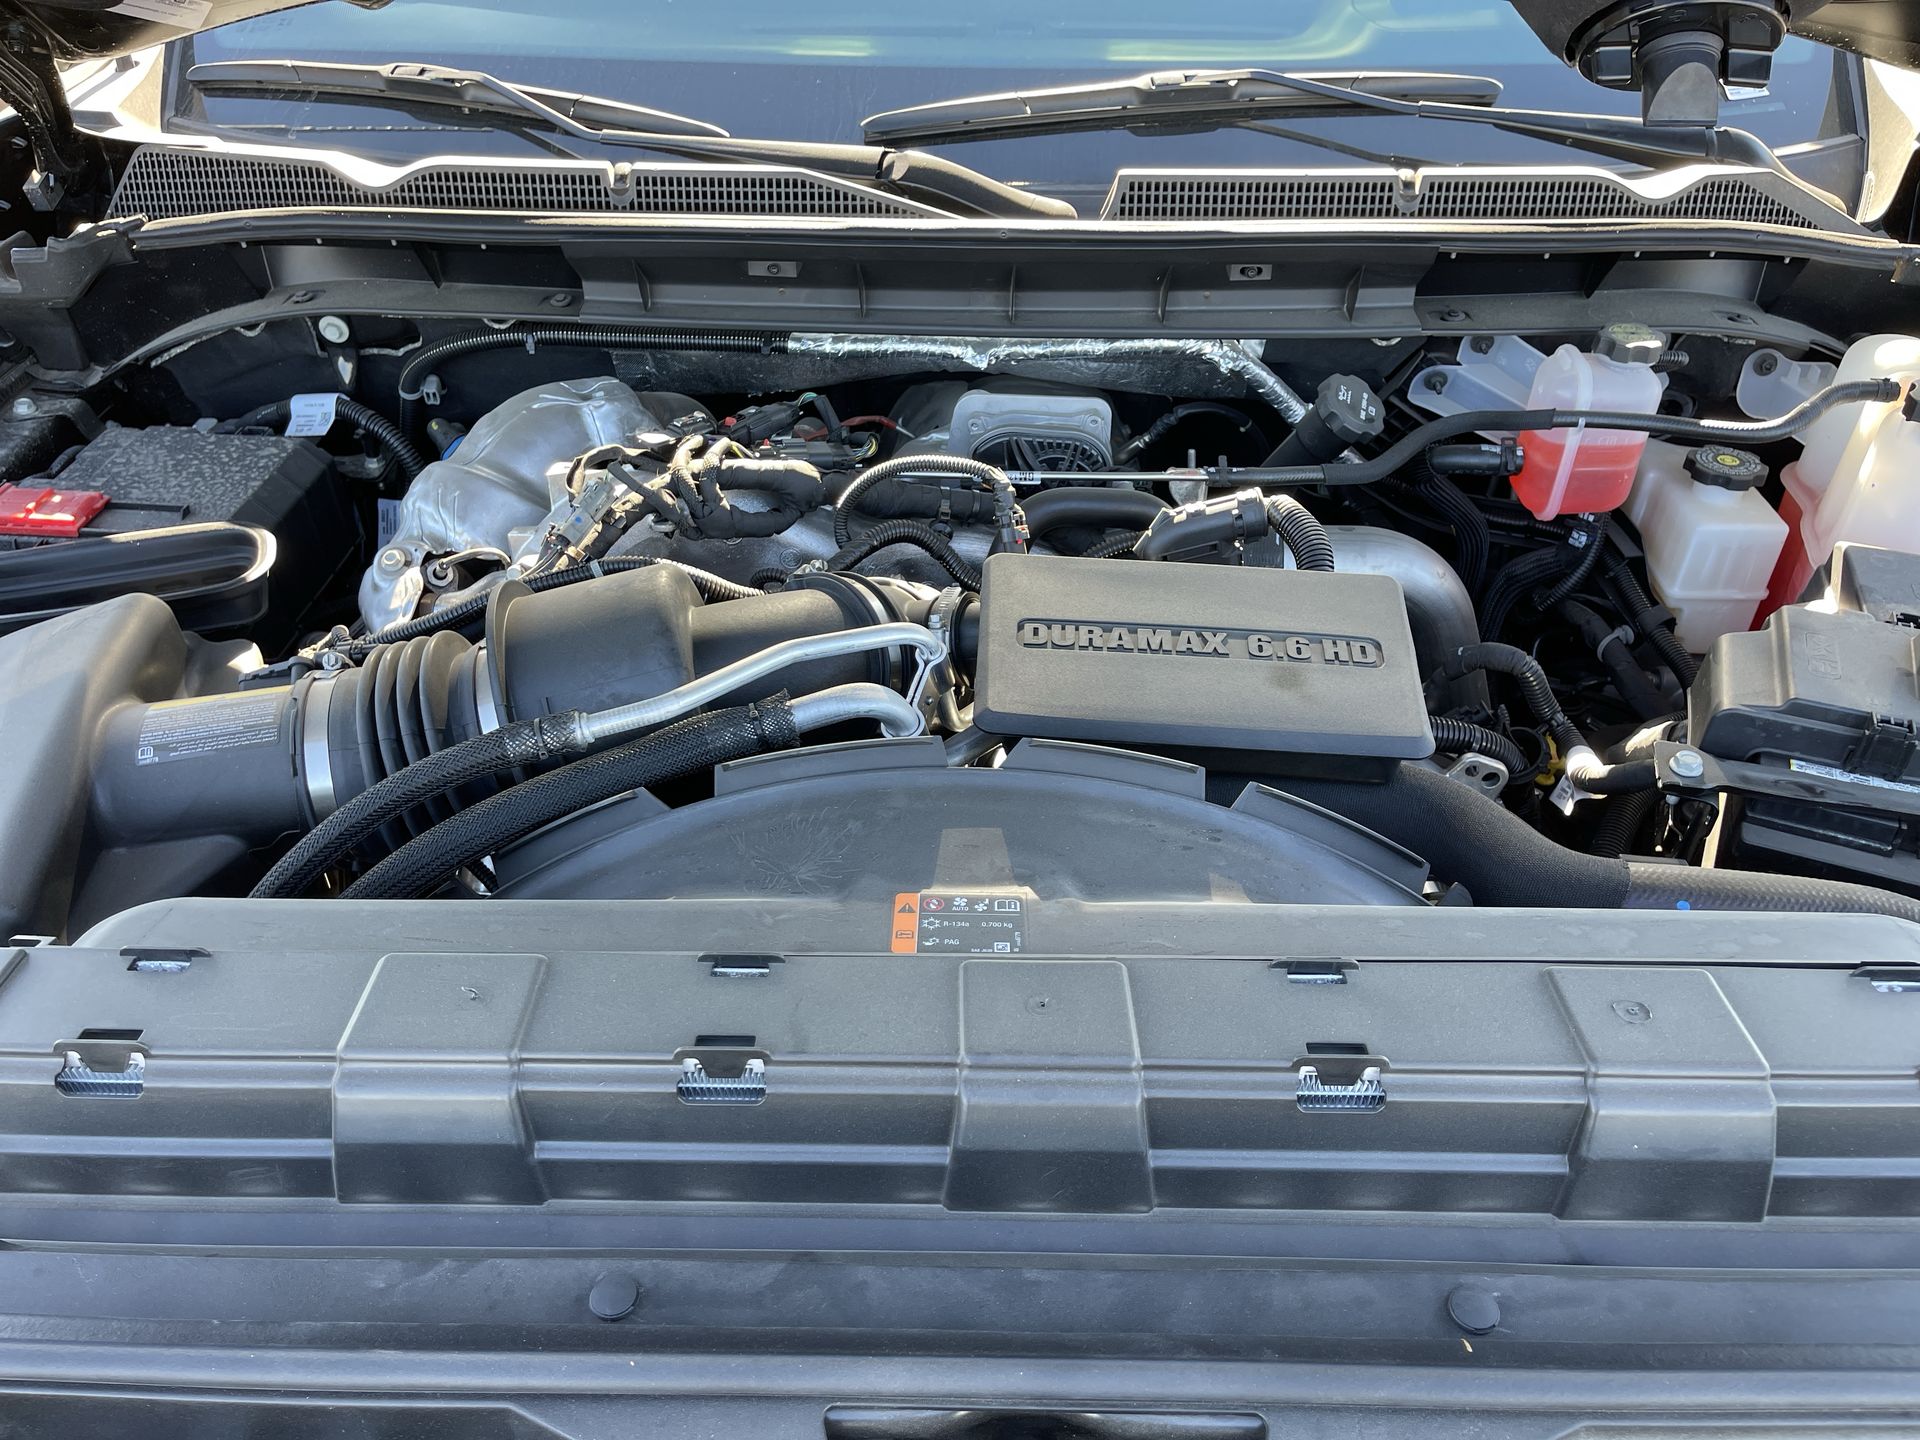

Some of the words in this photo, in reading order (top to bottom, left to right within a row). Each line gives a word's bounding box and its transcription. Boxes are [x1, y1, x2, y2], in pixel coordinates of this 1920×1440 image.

[1023, 623, 1230, 658] DURAMAX
[1247, 634, 1312, 660] 6.6
[1322, 638, 1378, 665] HD
